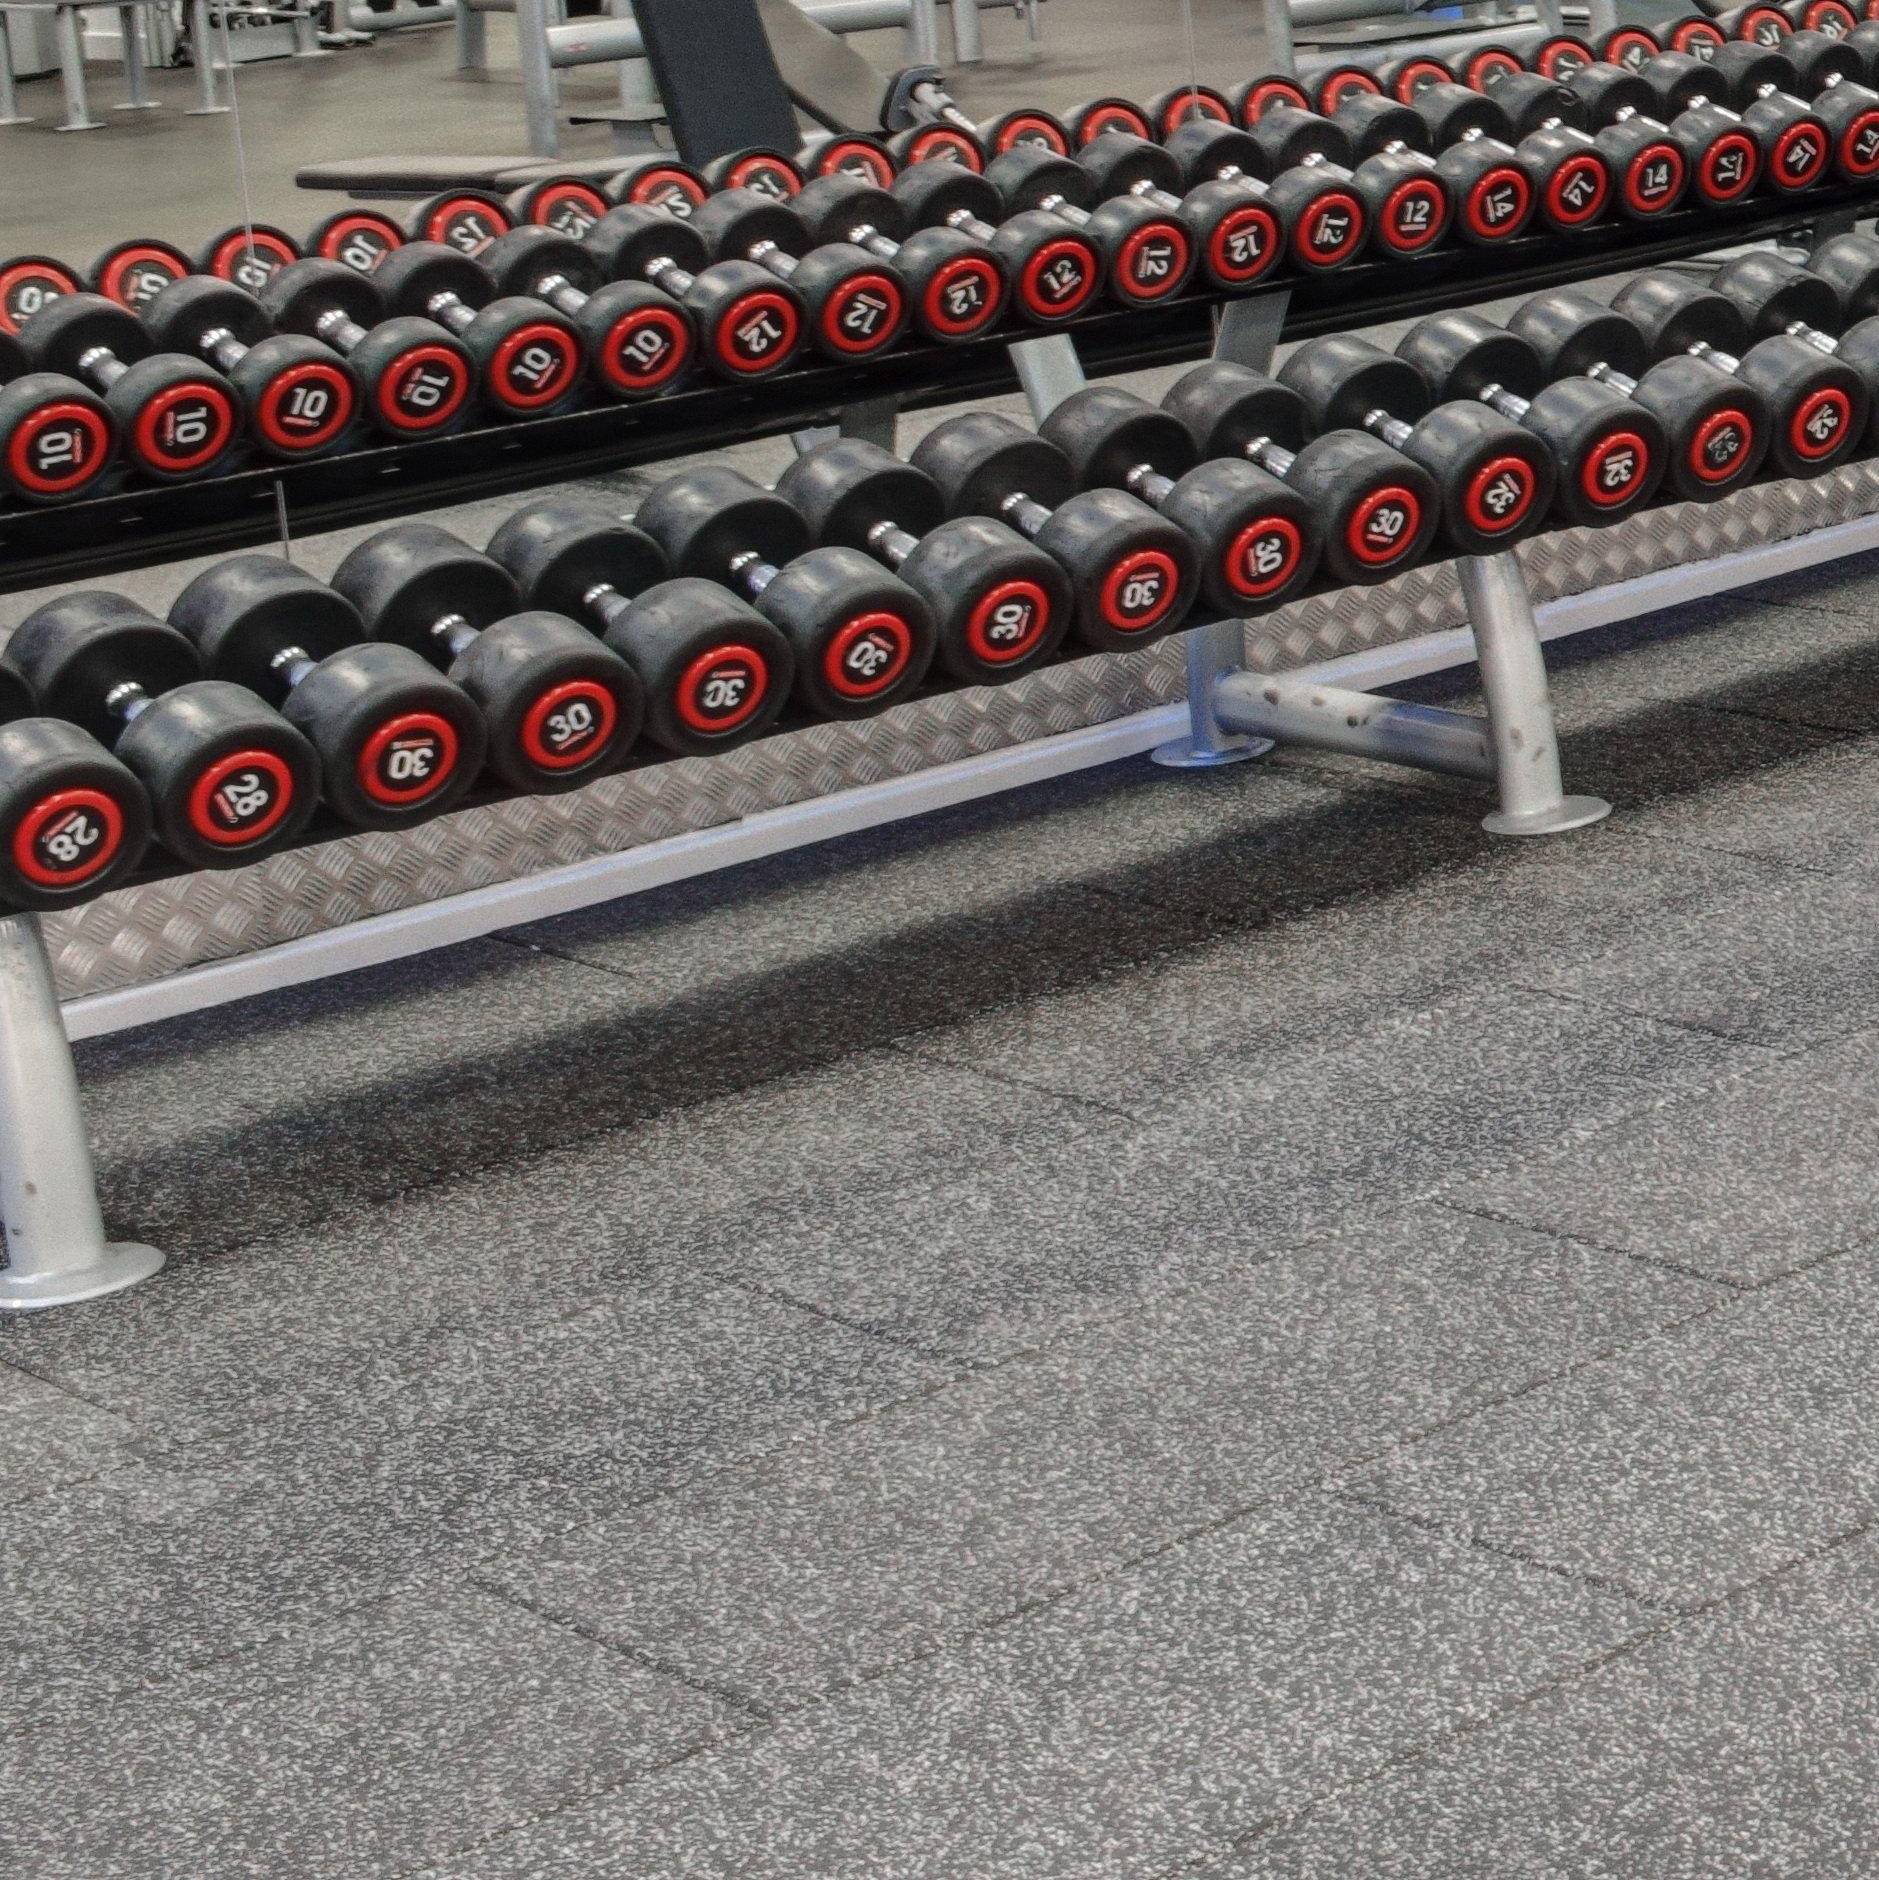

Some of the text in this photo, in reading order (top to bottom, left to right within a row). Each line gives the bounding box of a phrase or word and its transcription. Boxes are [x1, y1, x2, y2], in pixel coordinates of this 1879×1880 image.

[1646, 164, 1667, 187] 14
[1493, 187, 1514, 217] 14
[1568, 179, 1594, 206] 14
[1405, 200, 1430, 222] 12
[1145, 246, 1171, 276] 12
[1230, 234, 1261, 263] 12
[950, 285, 982, 314] 12
[843, 300, 878, 333] 12
[622, 329, 662, 363] 10
[741, 320, 781, 352] 12
[512, 347, 551, 380] 10
[291, 387, 328, 418] 10
[410, 375, 449, 406] 10
[176, 406, 207, 443] 10
[39, 432, 73, 469] 10
[1603, 459, 1633, 486] 32
[1369, 508, 1404, 536] 30
[1255, 537, 1282, 573] 30
[1121, 580, 1159, 608] 30
[989, 604, 1022, 640] 30
[849, 640, 887, 676] 30
[702, 678, 745, 708] 30
[547, 702, 592, 742] 30
[388, 747, 433, 779] 30
[223, 774, 268, 816] 28
[48, 815, 98, 861] 28
